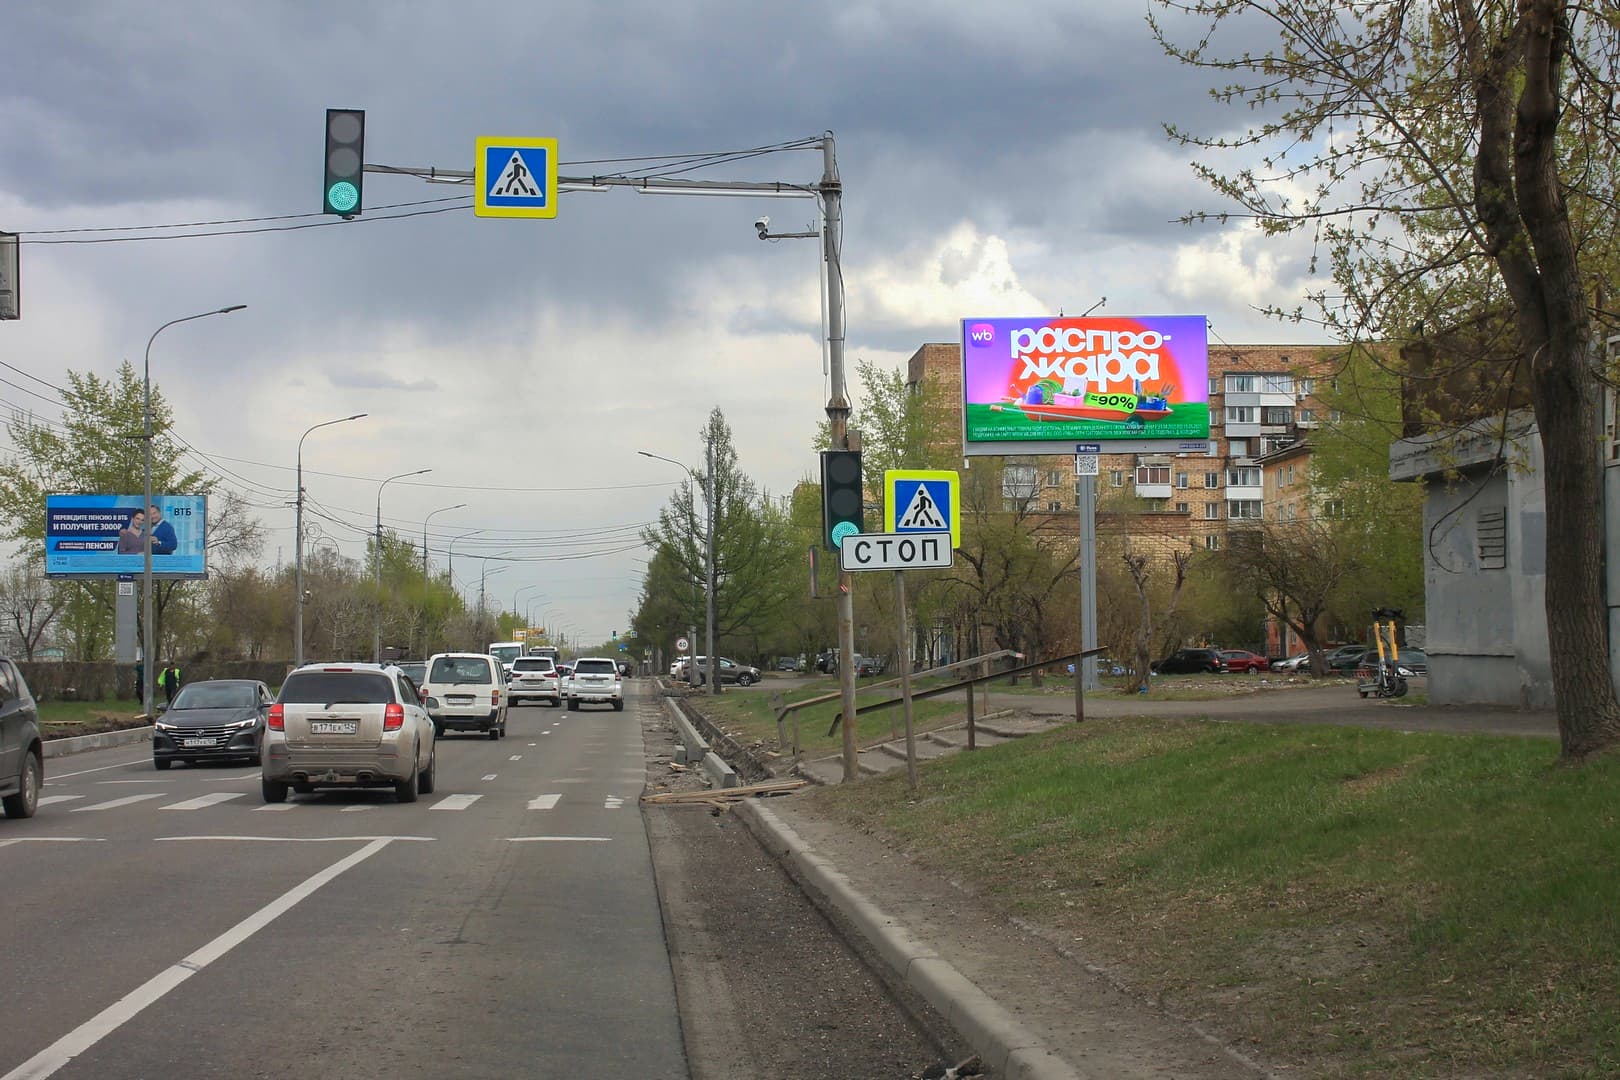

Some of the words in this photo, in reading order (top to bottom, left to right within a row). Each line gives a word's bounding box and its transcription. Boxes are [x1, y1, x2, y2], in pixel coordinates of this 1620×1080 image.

[971, 328, 993, 341] wb
[1010, 326, 1172, 359] распро-
[1019, 350, 1160, 393] жара
[173, 507, 192, 516] ВТБ
[53, 523, 59, 531] И
[60, 523, 100, 531] ПОЛУЧИТЕ
[85, 542, 114, 550] ПЕНСИЯ
[854, 538, 939, 564] СТОП
